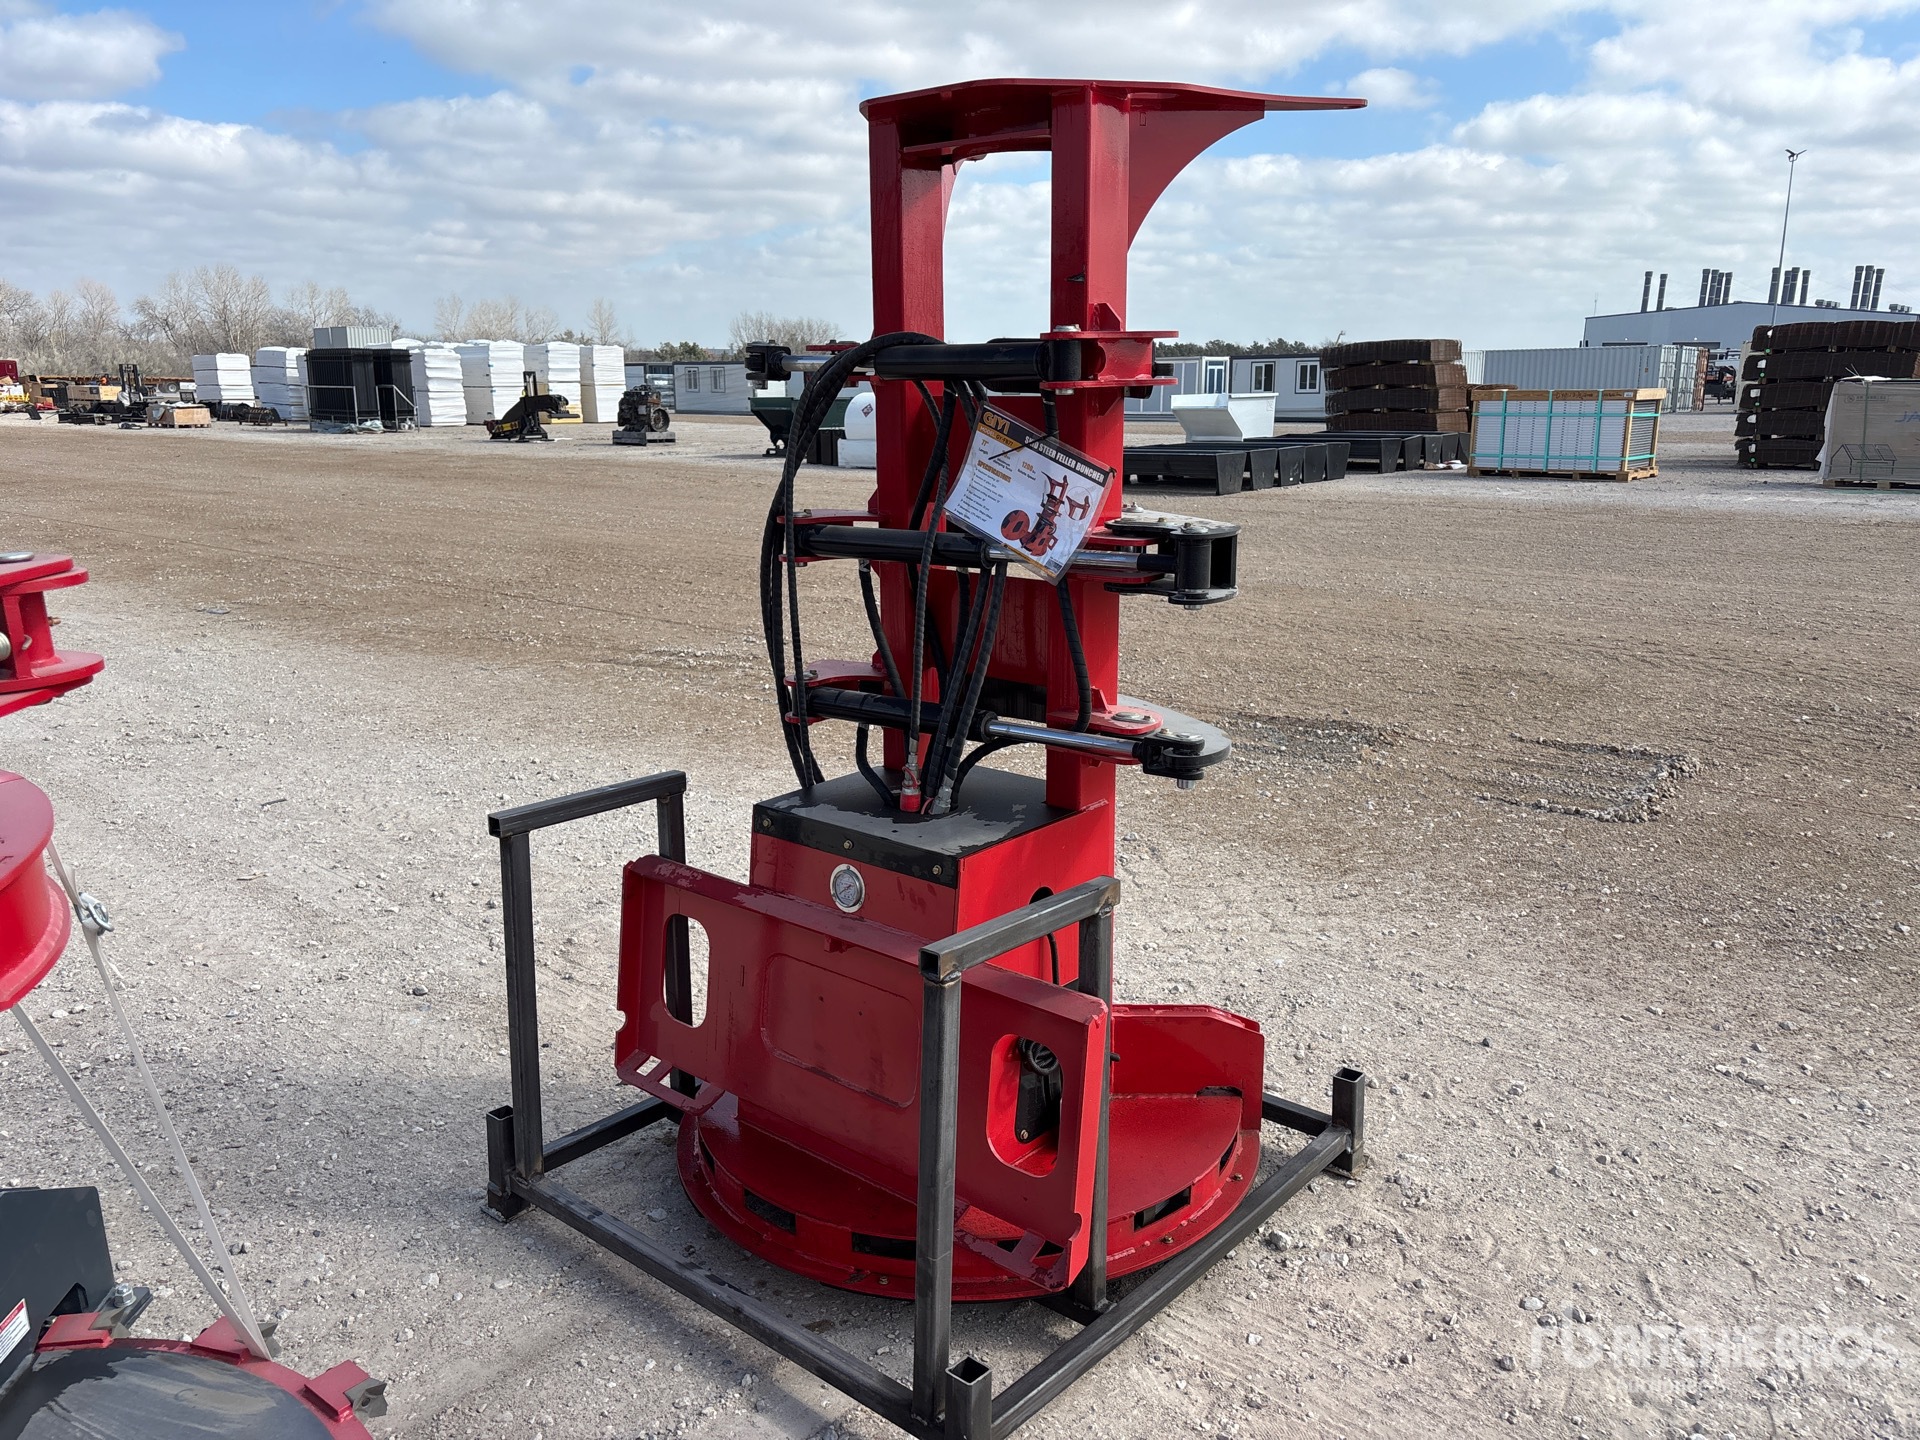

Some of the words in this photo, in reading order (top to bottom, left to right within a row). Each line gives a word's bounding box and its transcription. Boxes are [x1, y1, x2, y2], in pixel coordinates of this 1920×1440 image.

[1039, 443, 1057, 459] STEER
[1056, 451, 1076, 469] FELLER
[1076, 462, 1105, 483] BUNCHER
